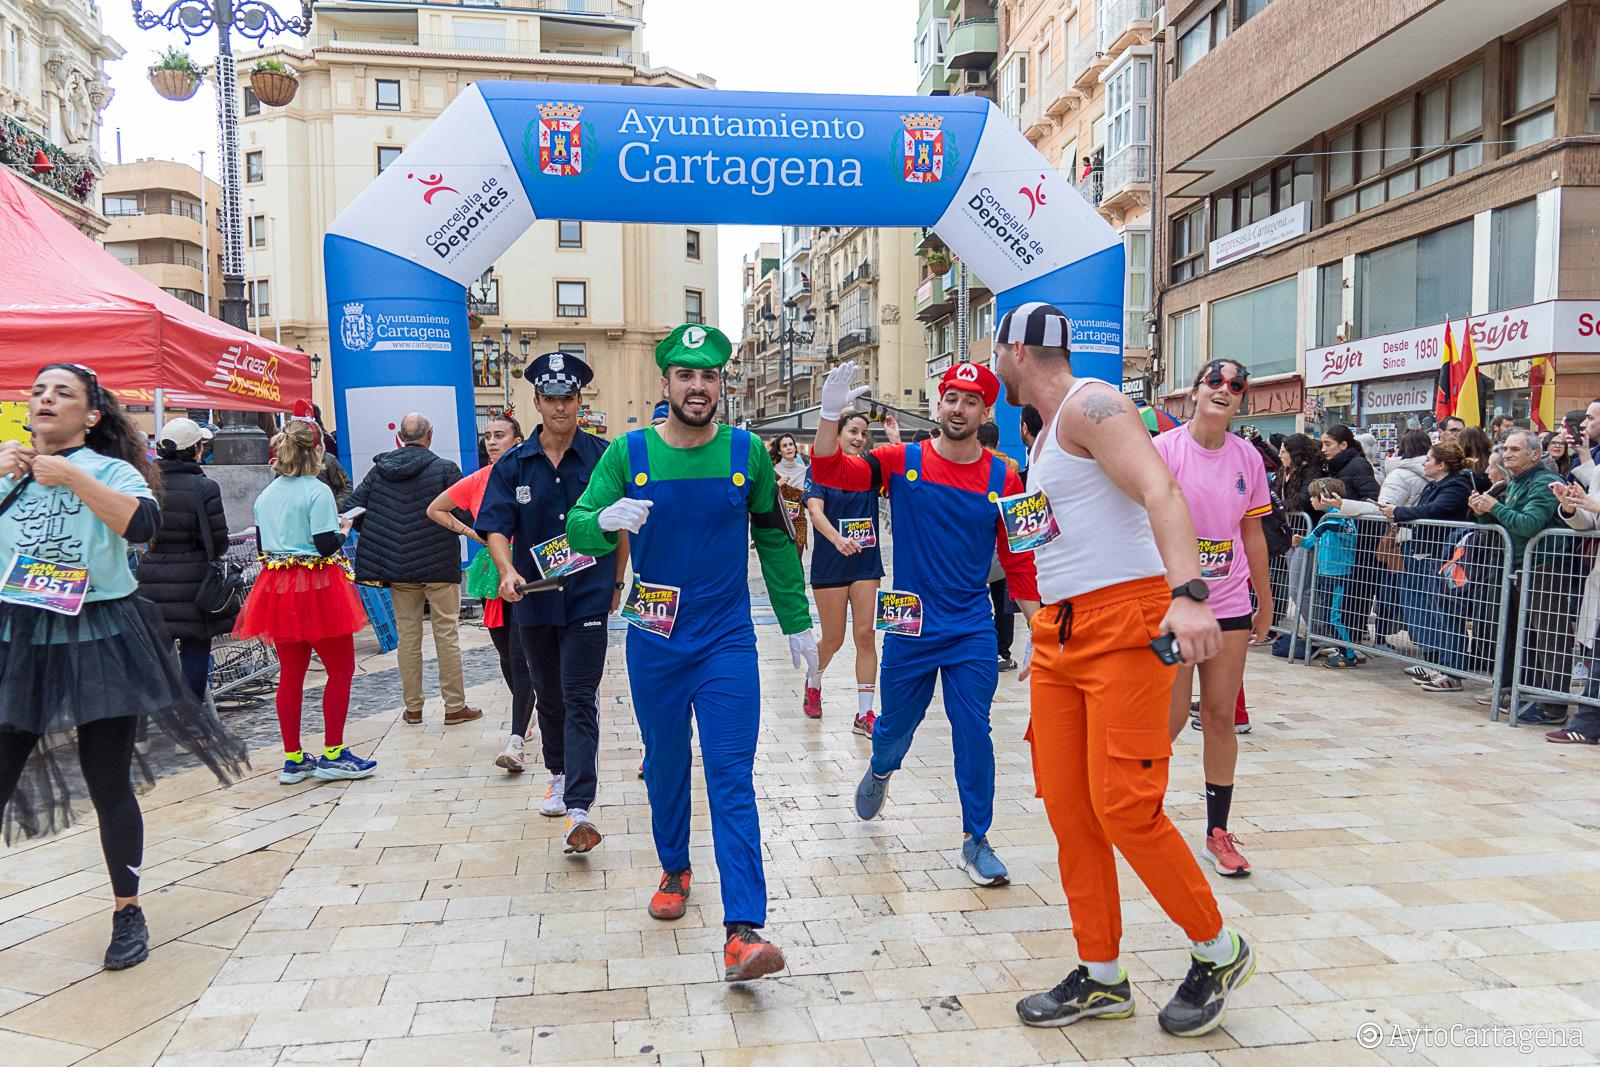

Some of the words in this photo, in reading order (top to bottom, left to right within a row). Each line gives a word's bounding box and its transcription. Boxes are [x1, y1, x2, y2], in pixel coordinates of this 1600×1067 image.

[618, 108, 865, 142] Ayuntamiento
[618, 141, 863, 196] Cartagena
[481, 177, 498, 193] de
[433, 187, 508, 258] Deportes
[980, 187, 1029, 241] Concejalía
[1029, 240, 1044, 255] de
[968, 194, 1035, 265] Deportes
[376, 313, 450, 325] Ayuntamiento
[1068, 318, 1120, 329] Ayuntamiento
[377, 324, 451, 340] Cartagena
[688, 331, 700, 345] L
[392, 341, 450, 350] www.cartagena.es
[1383, 340, 1409, 354] Desde
[1414, 337, 1438, 360] 1950
[1383, 357, 1406, 369] Since
[959, 367, 975, 379] M
[1367, 386, 1427, 408] Souvenirs
[12, 489, 83, 522] SAN
[1015, 495, 1036, 511] SAN
[16, 517, 72, 547] SIL
[847, 529, 871, 540] 2872
[544, 539, 558, 550] SAN
[546, 538, 568, 556] SILVES
[546, 547, 571, 569] 257
[1199, 553, 1227, 567] 873
[28, 567, 88, 580] SILVESTRE
[31, 562, 56, 571] SAN
[22, 574, 74, 598] 1951
[640, 589, 673, 600] VESTRE
[634, 597, 667, 620] 510
[882, 606, 913, 621] 2514
